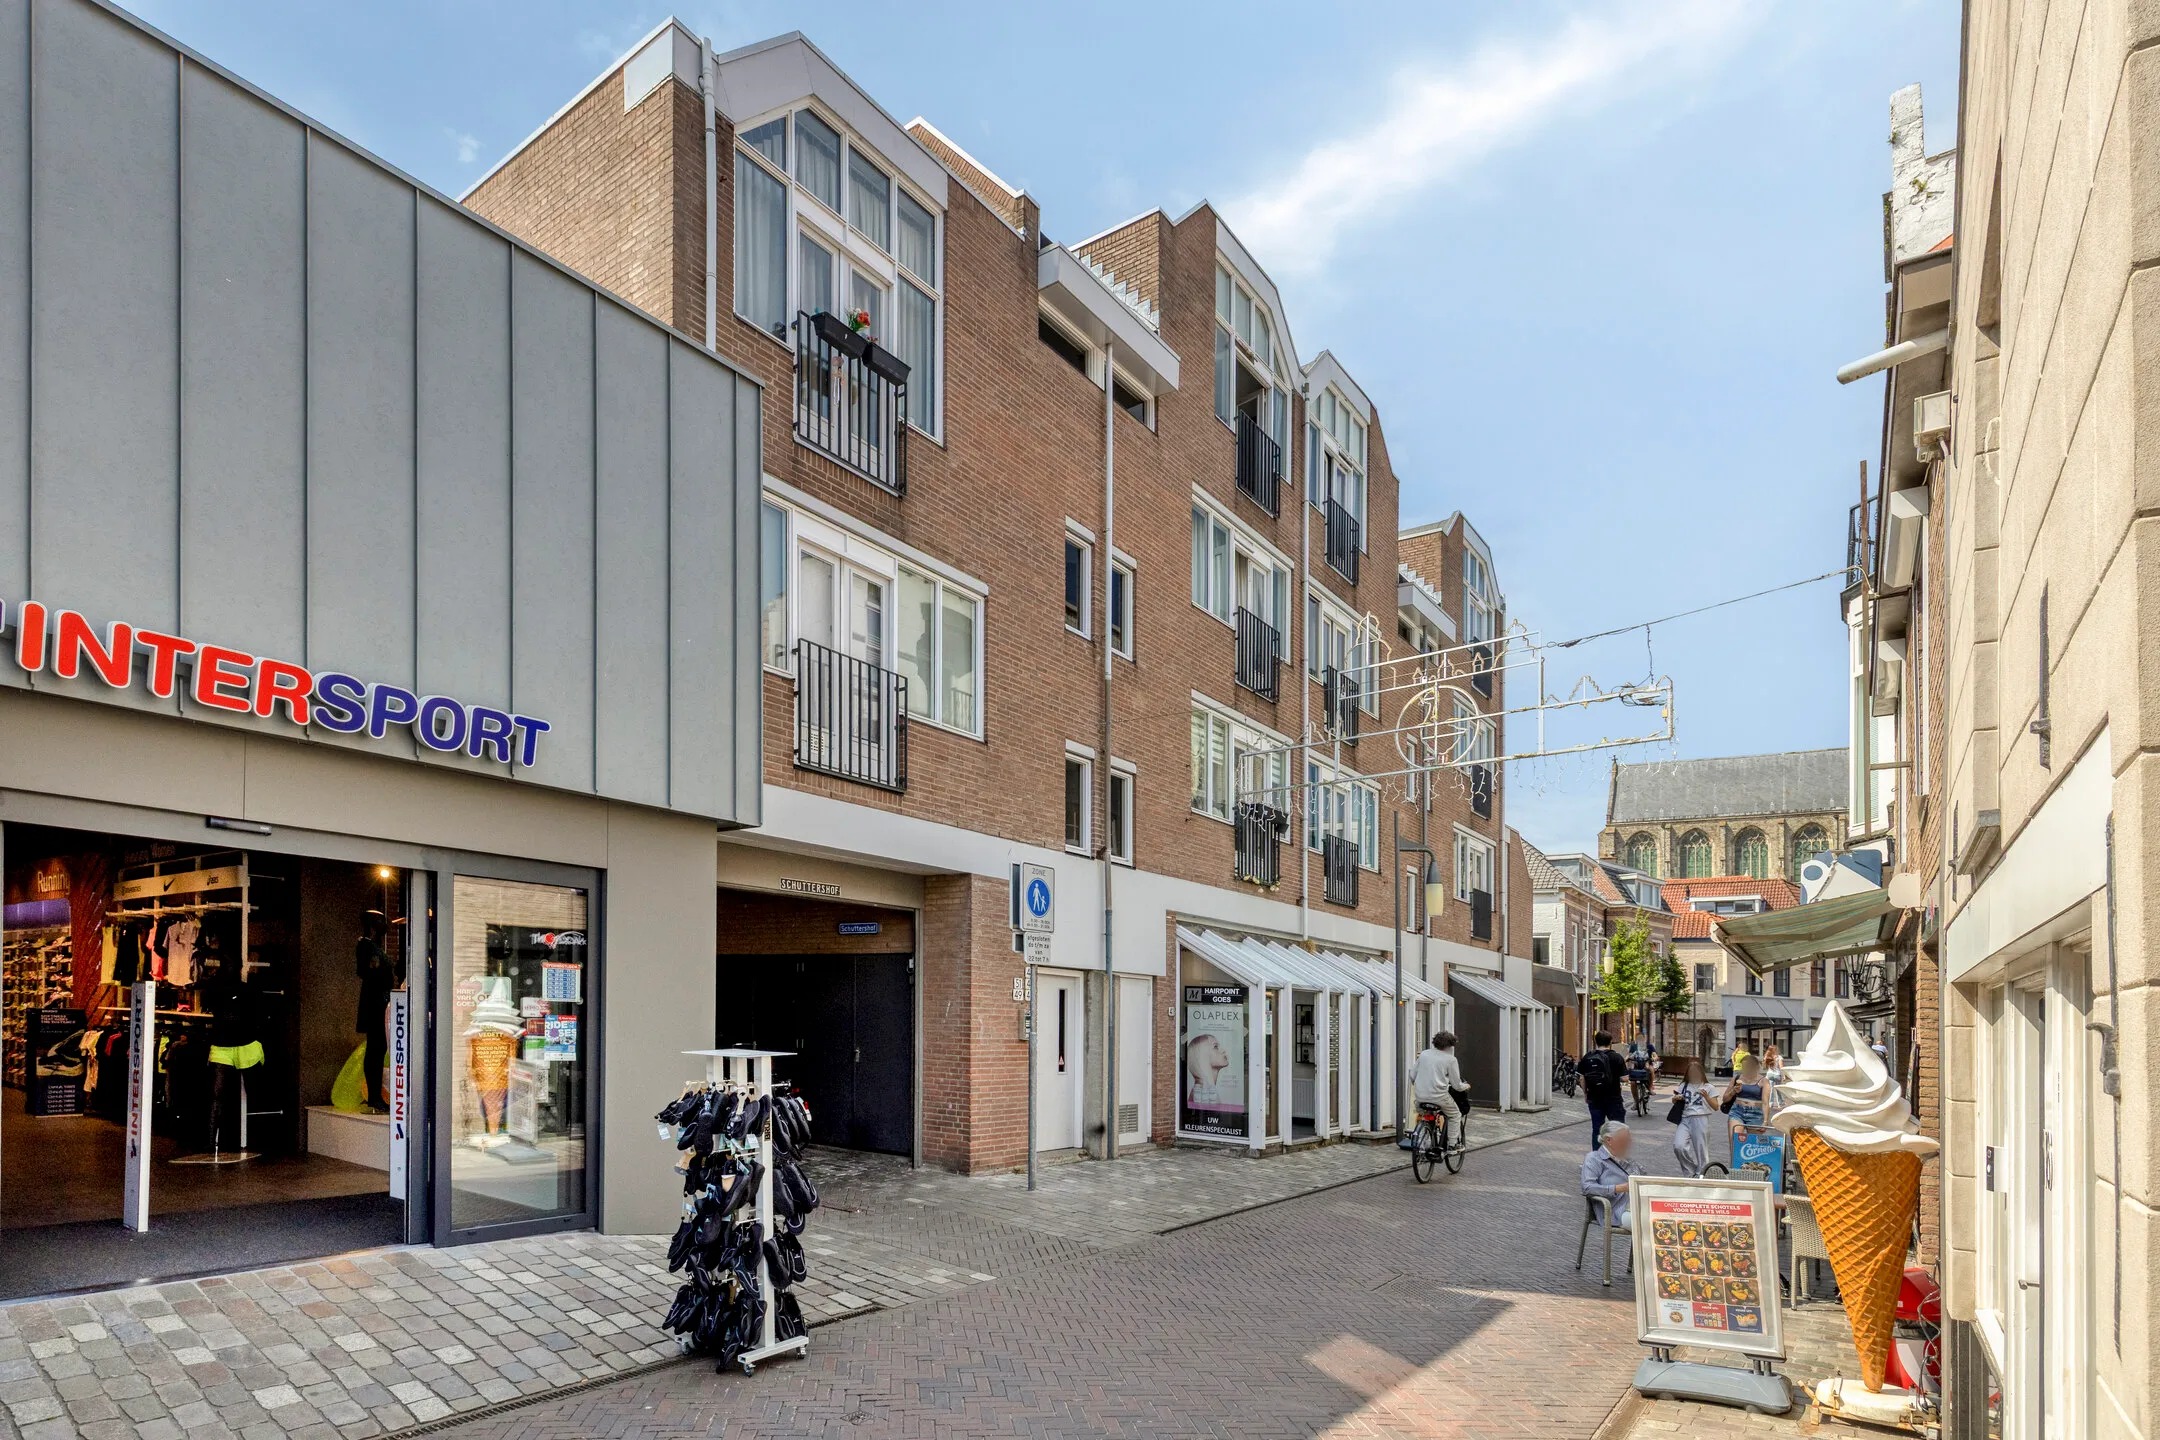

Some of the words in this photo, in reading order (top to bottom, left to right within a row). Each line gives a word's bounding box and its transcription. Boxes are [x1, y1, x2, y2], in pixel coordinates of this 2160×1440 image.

[15, 600, 552, 768] INTERSPORT
[1031, 867, 1047, 877] ZONE
[37, 870, 71, 895] Running
[781, 879, 839, 895] SCHUTTERSHOF
[840, 923, 876, 933] Schuttershof
[1015, 978, 1022, 988] 51
[1204, 987, 1240, 995] HAIRPOINT
[1192, 1010, 1239, 1021] OLAPLEX
[545, 1020, 569, 1029] RIDE
[131, 997, 142, 1137] INTERSPORT
[395, 1001, 405, 1121] INTERSPORT
[1184, 1123, 1243, 1136] KLEURENSPECIALIST
[1740, 1142, 1777, 1160] Cornetto
